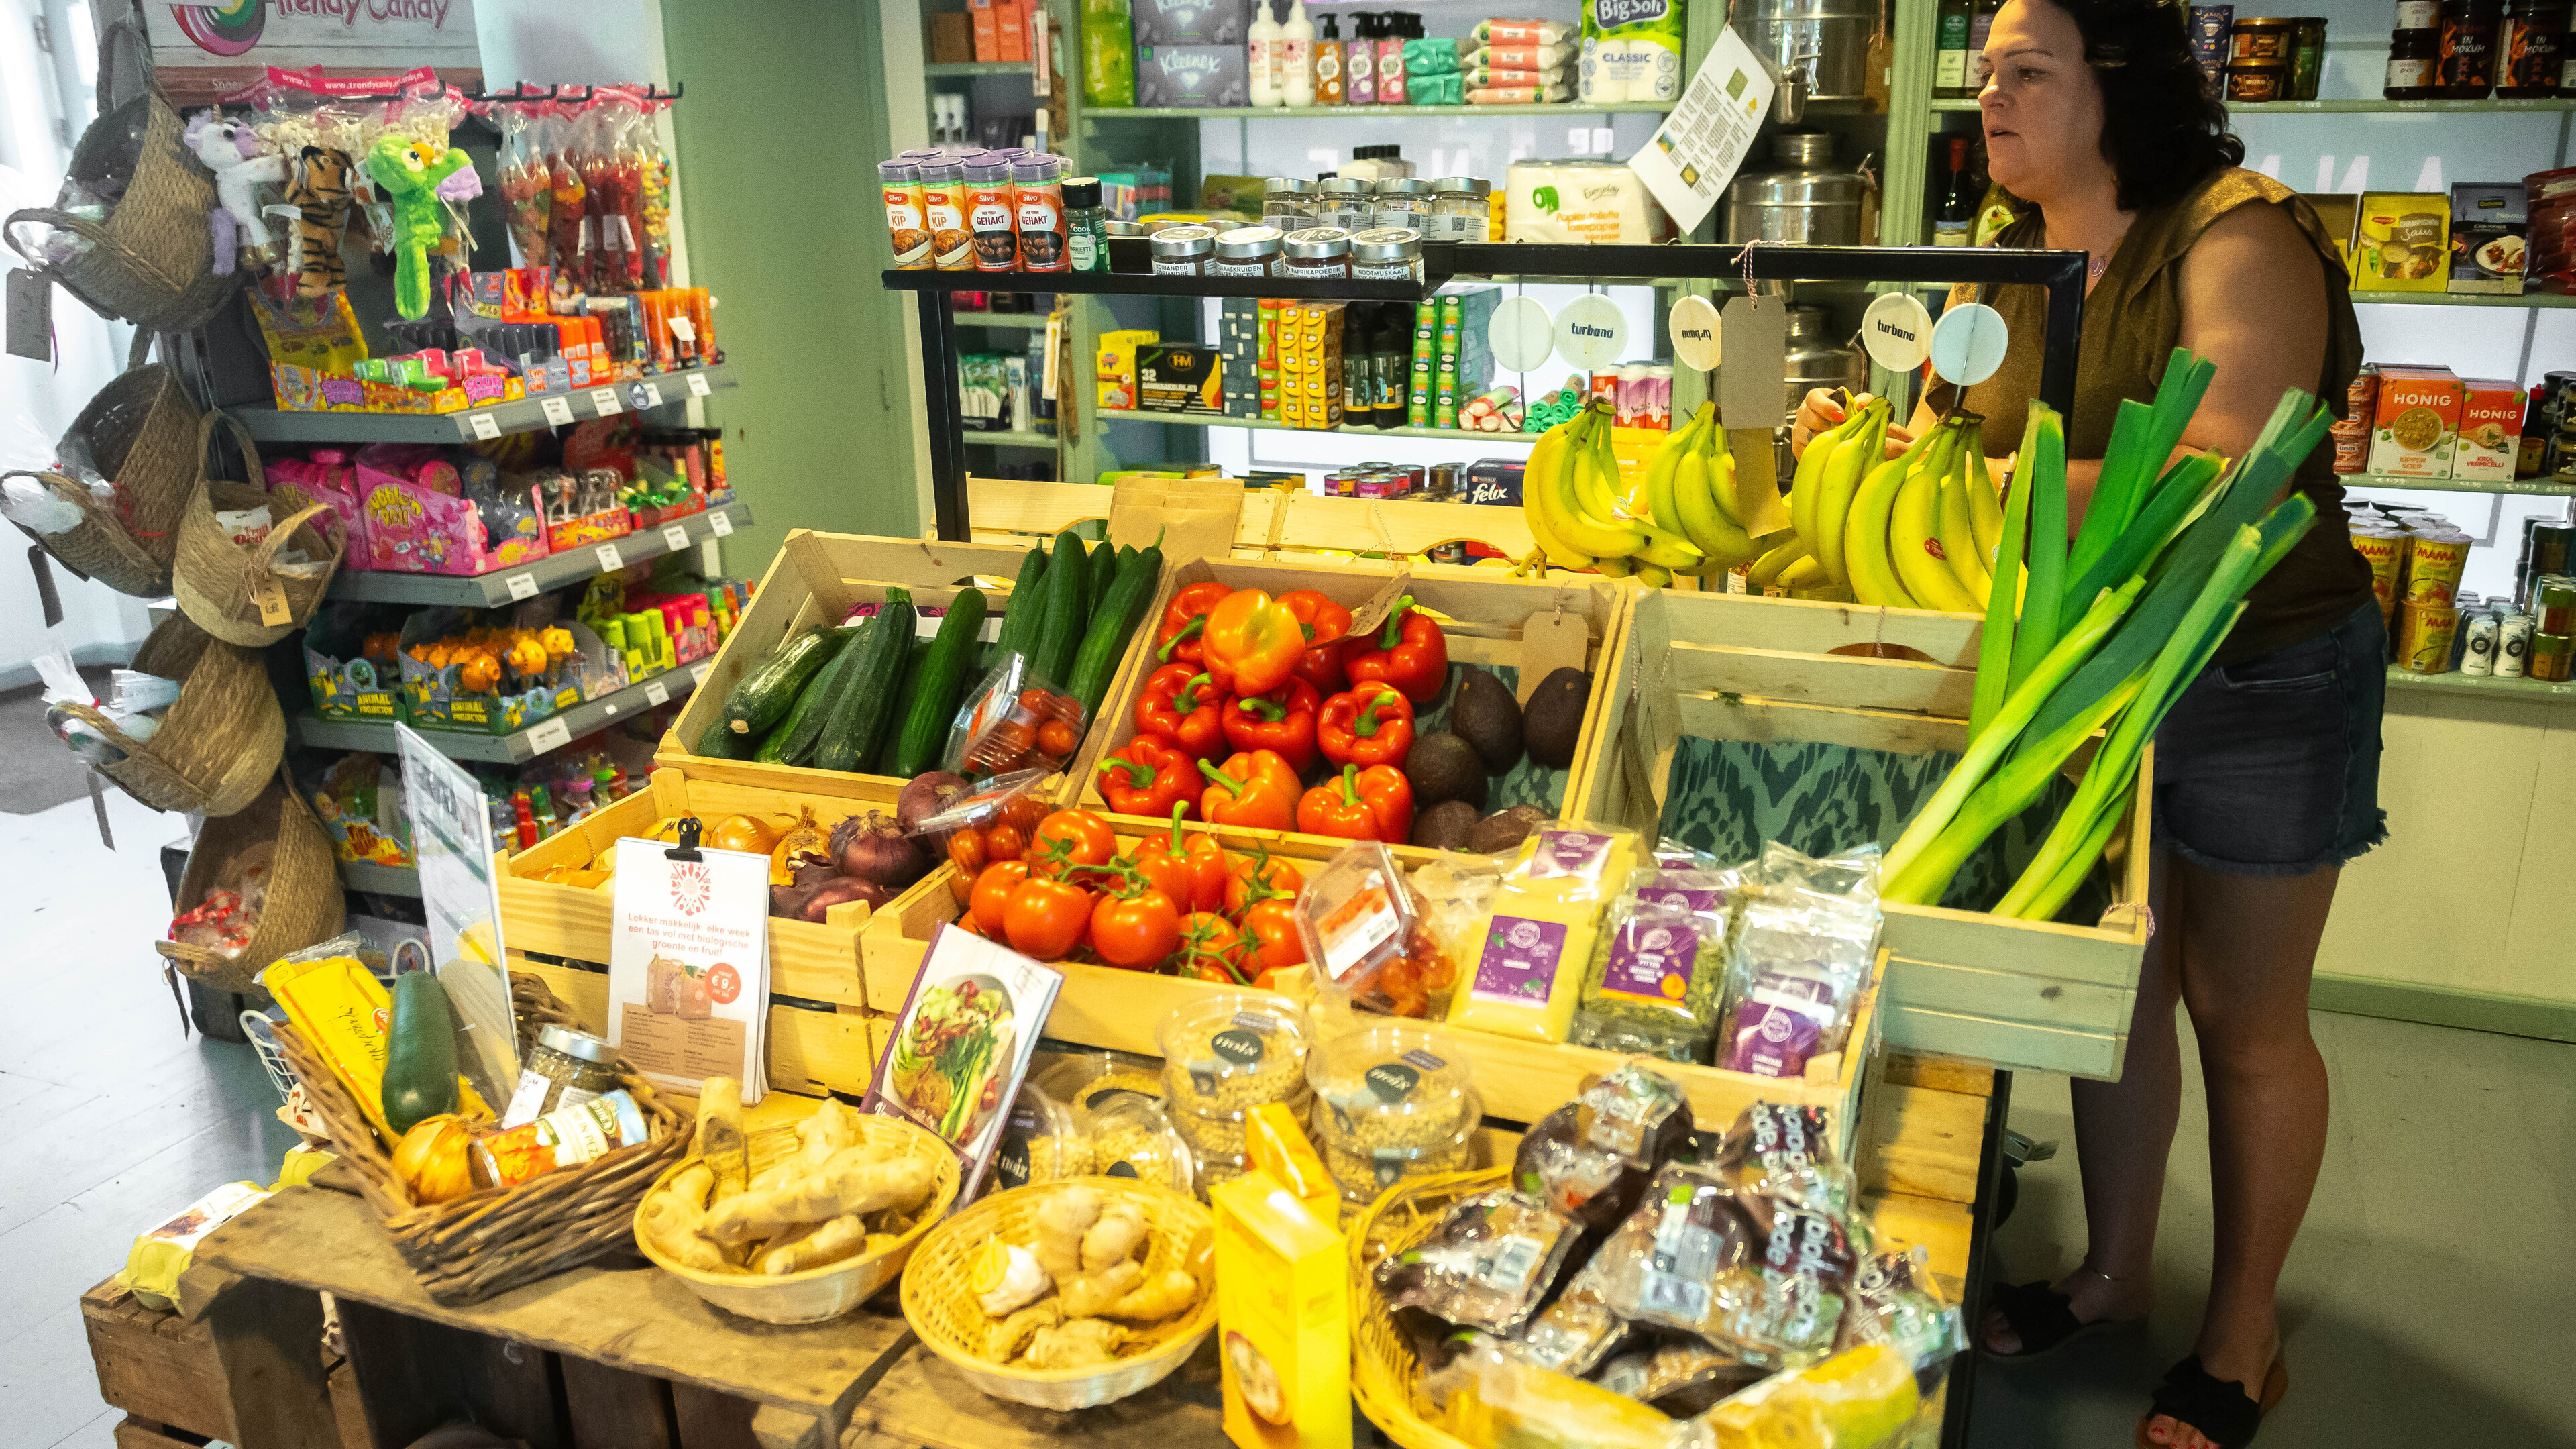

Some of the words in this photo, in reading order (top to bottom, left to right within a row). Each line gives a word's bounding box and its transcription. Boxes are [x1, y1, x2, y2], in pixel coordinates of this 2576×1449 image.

[367, 0, 449, 29] Candy
[2462, 36, 2473, 44] IN
[2452, 44, 2485, 54] MOKUM
[1159, 50, 1221, 76] Kleenex
[1602, 52, 1651, 64] CLASSIC
[892, 215, 906, 227] KIP
[932, 216, 947, 227] KIP
[977, 215, 1004, 225] GEHAKT
[1022, 215, 1048, 225] GEHAKT
[1291, 267, 1340, 275] PAPRIKAPOEDER
[1877, 319, 1915, 342] turbana
[1142, 368, 1157, 382] 32
[2394, 394, 2451, 407] HONIG
[2469, 409, 2517, 420] HONIG
[1470, 483, 1508, 504] felix
[2416, 547, 2457, 561] MAMA
[628, 912, 658, 924] Lekker
[706, 924, 725, 934] elke
[727, 928, 751, 938] week
[628, 925, 644, 934] een
[646, 926, 659, 936] tas
[662, 928, 676, 938] vol
[678, 930, 695, 941] met
[697, 933, 749, 950] biologische
[652, 940, 686, 953] groente
[688, 945, 699, 953] en
[702, 947, 722, 957] fruit!
[711, 975, 719, 987] €
